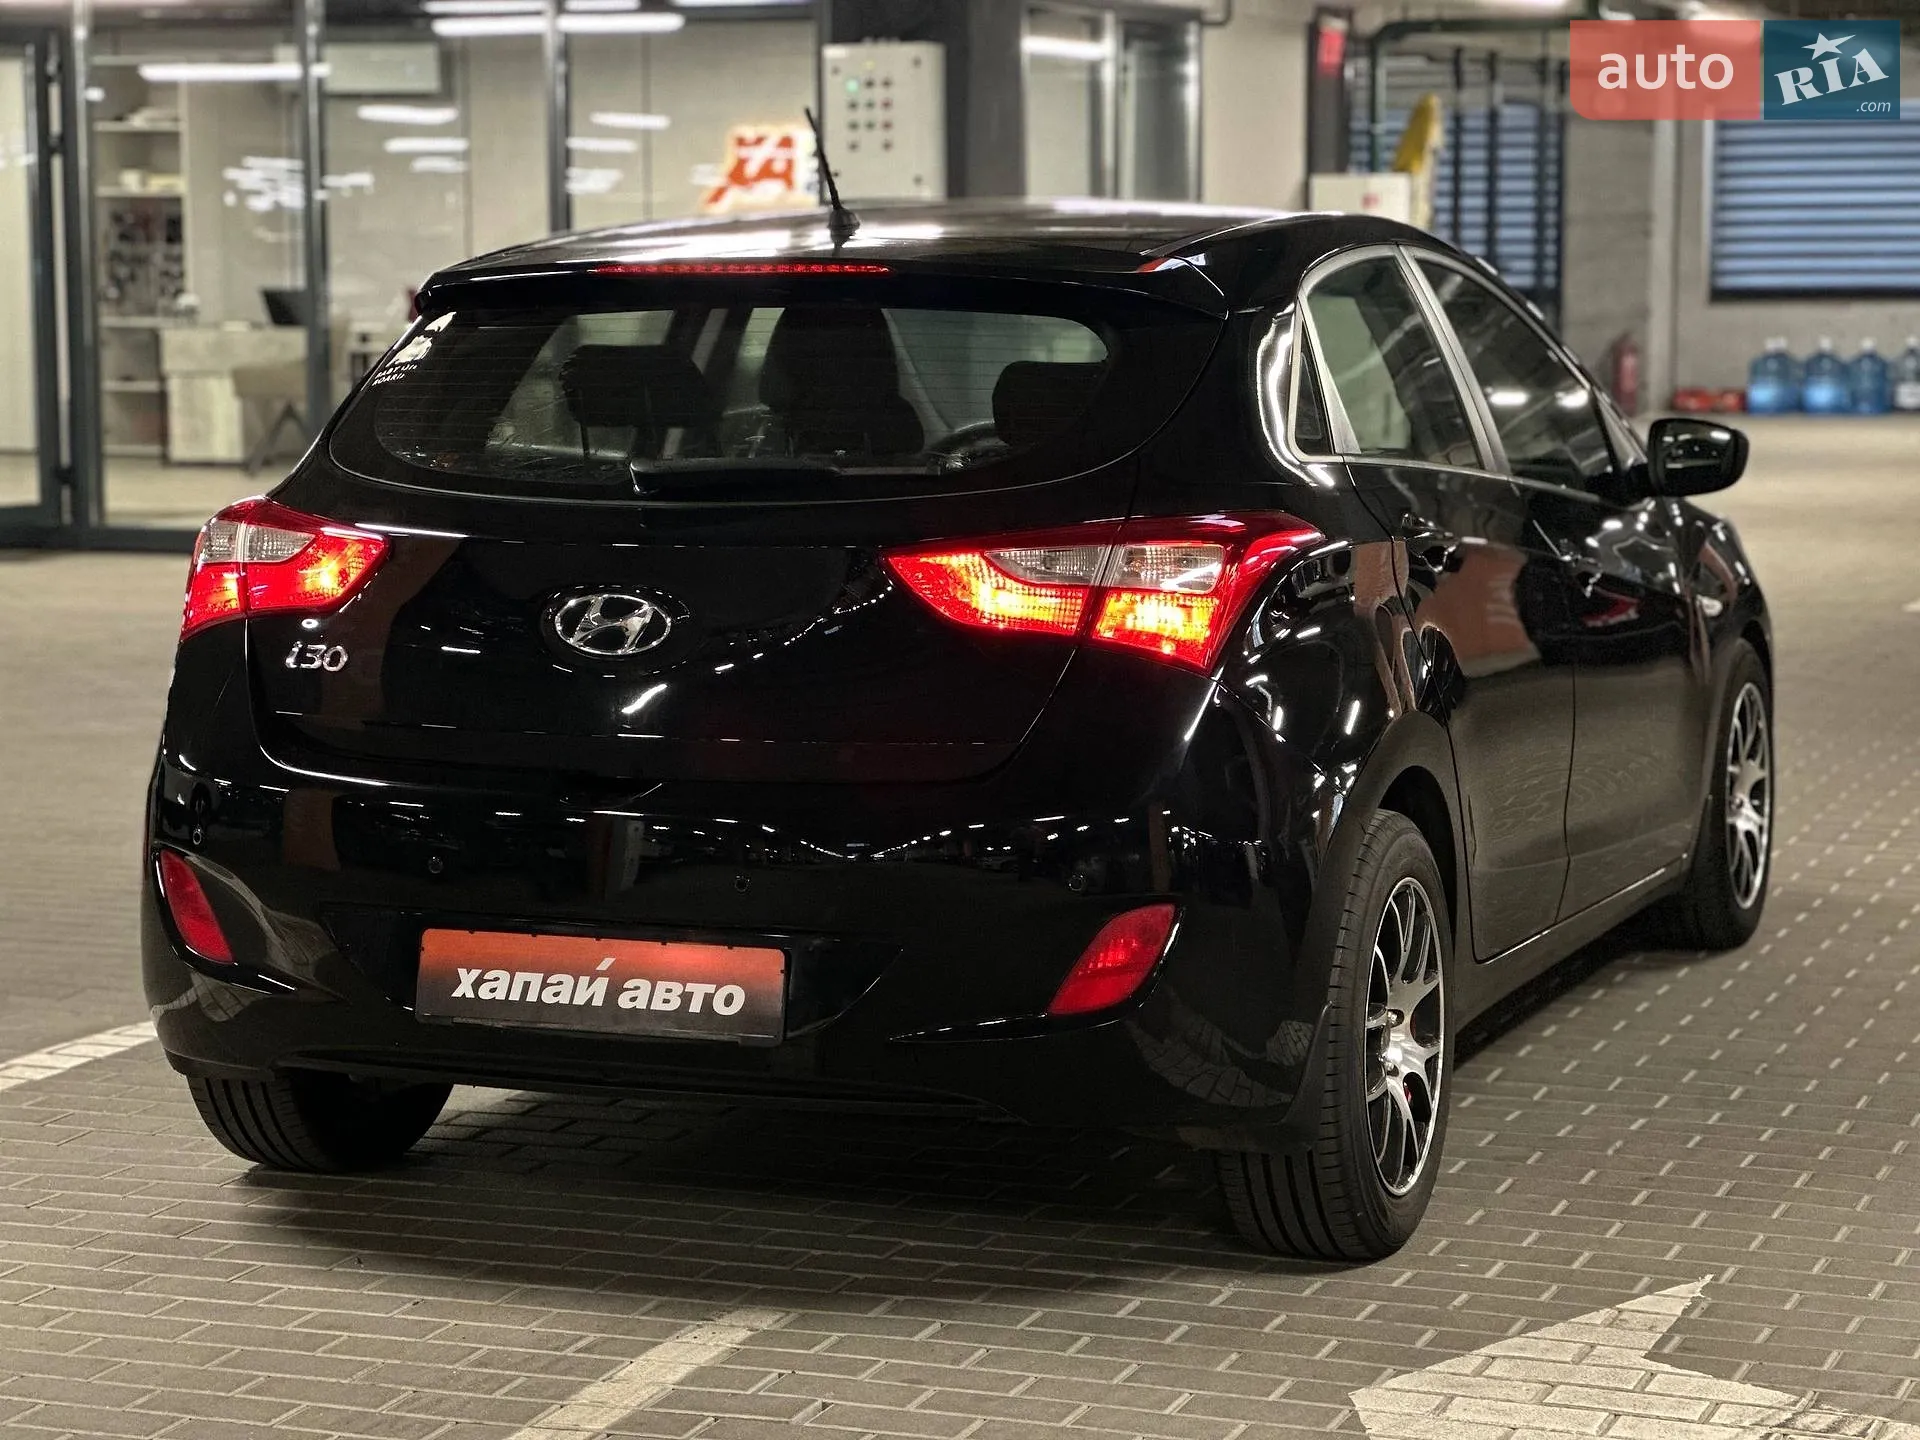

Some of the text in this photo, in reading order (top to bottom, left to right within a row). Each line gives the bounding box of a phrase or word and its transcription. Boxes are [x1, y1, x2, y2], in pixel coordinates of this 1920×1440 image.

[285, 640, 349, 672] i30
[451, 957, 746, 1016] хапай авто
